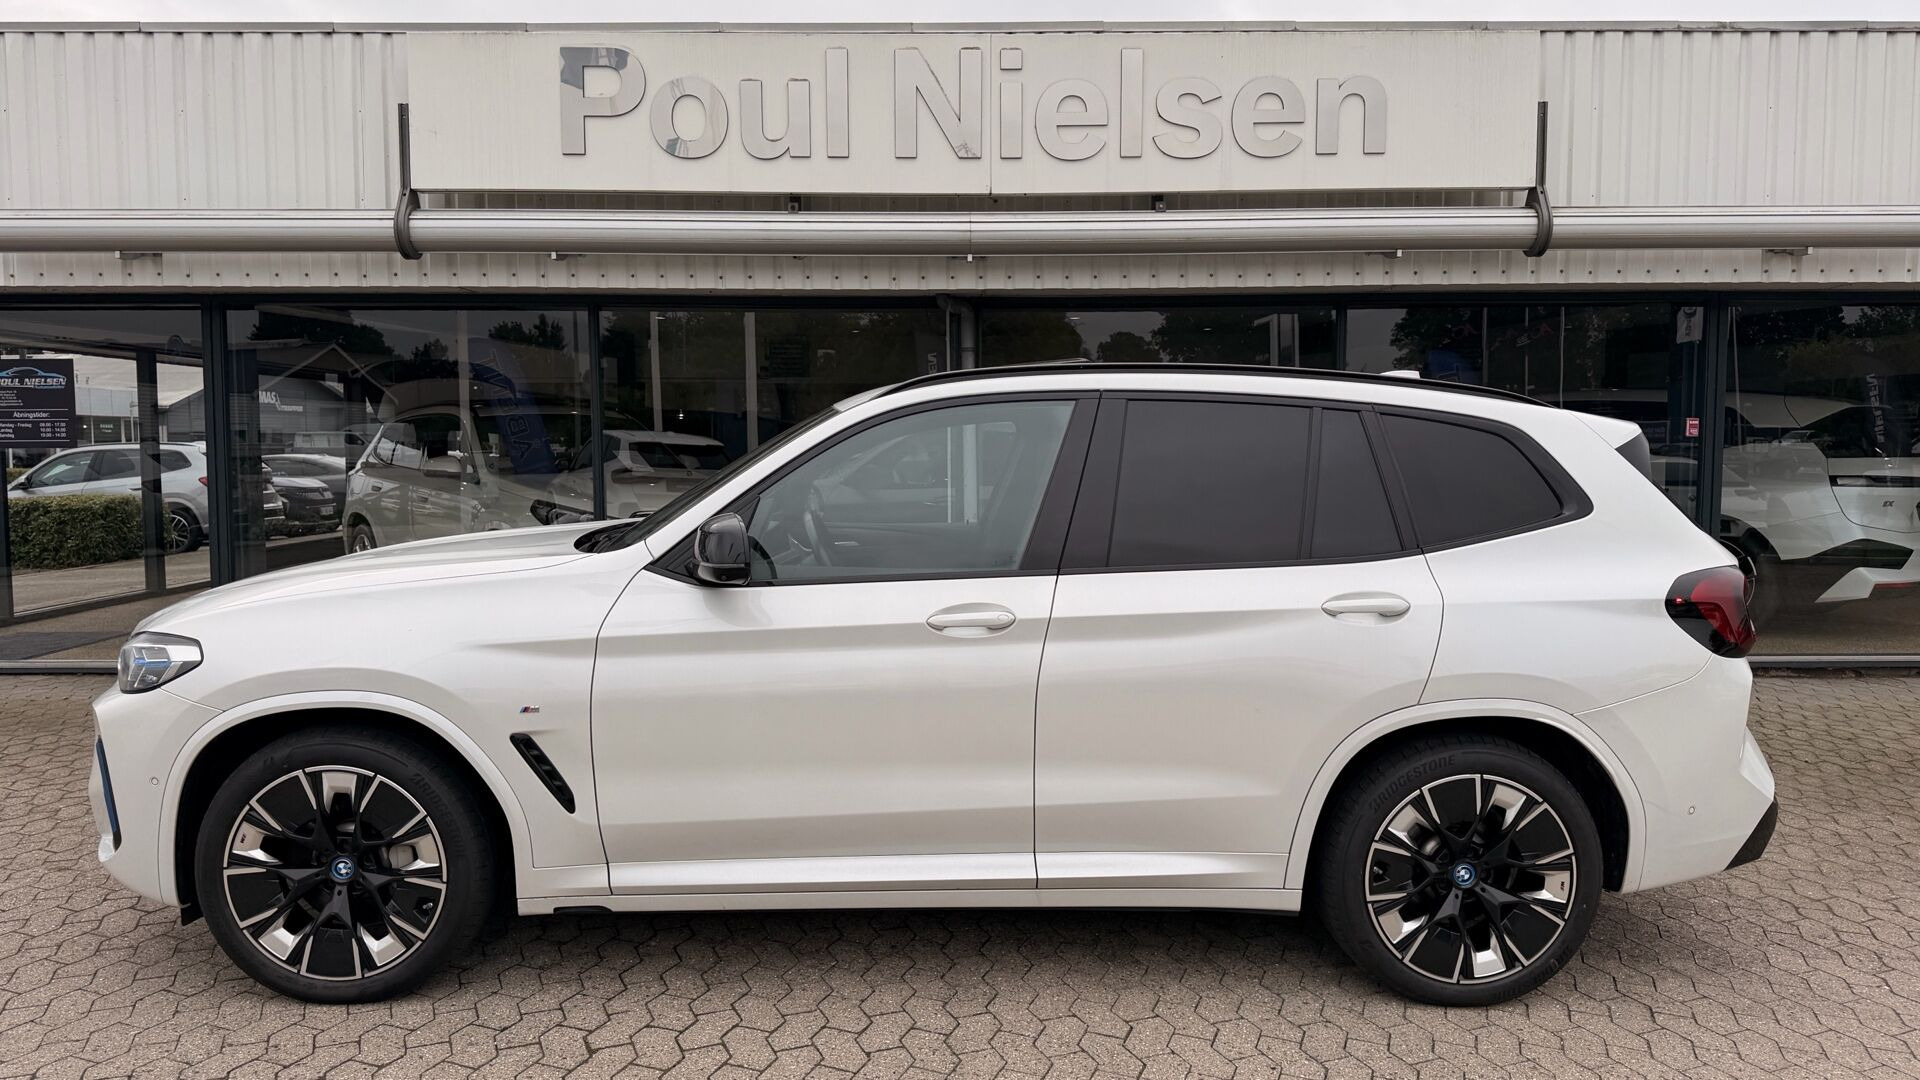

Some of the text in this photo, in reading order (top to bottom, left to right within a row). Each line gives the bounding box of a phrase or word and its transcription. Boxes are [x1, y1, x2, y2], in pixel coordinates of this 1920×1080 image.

[559, 46, 1387, 160] Poul Nielsen
[0, 378, 20, 386] OUL
[24, 377, 66, 386] NIELSEN
[1369, 754, 1456, 813] BRIDGESTONE
